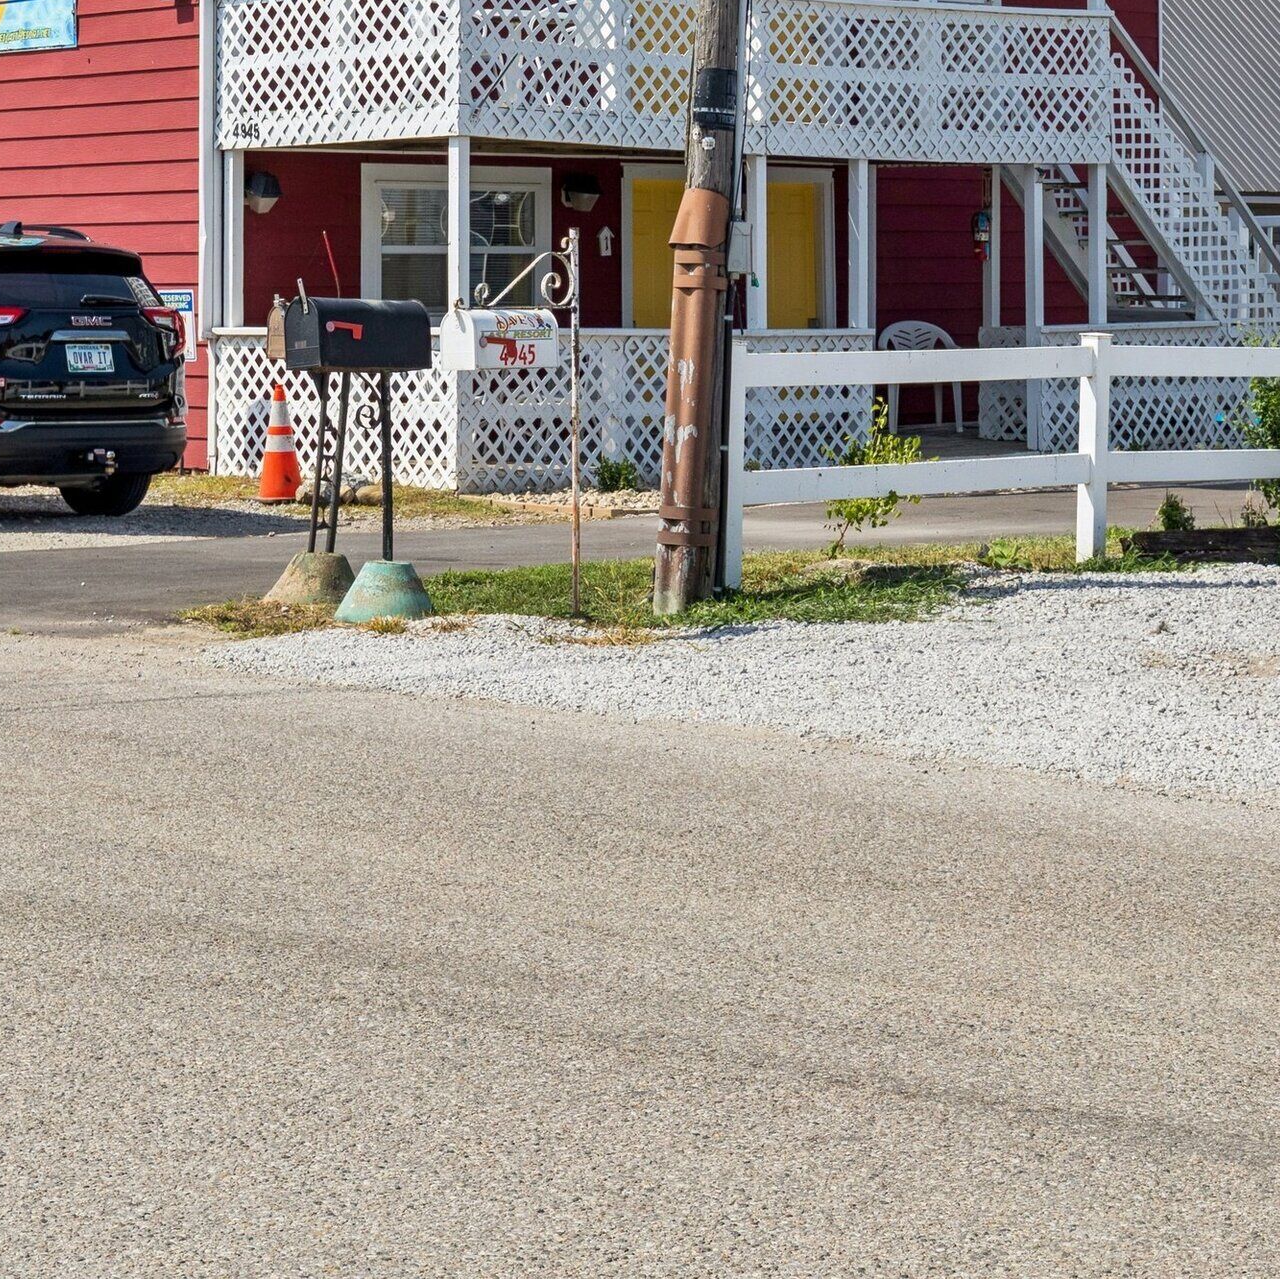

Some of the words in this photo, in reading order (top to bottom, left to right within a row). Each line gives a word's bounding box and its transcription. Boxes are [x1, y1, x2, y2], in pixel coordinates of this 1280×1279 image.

[232, 123, 260, 140] 4945
[71, 316, 112, 326] GMC
[98, 351, 107, 365] IT
